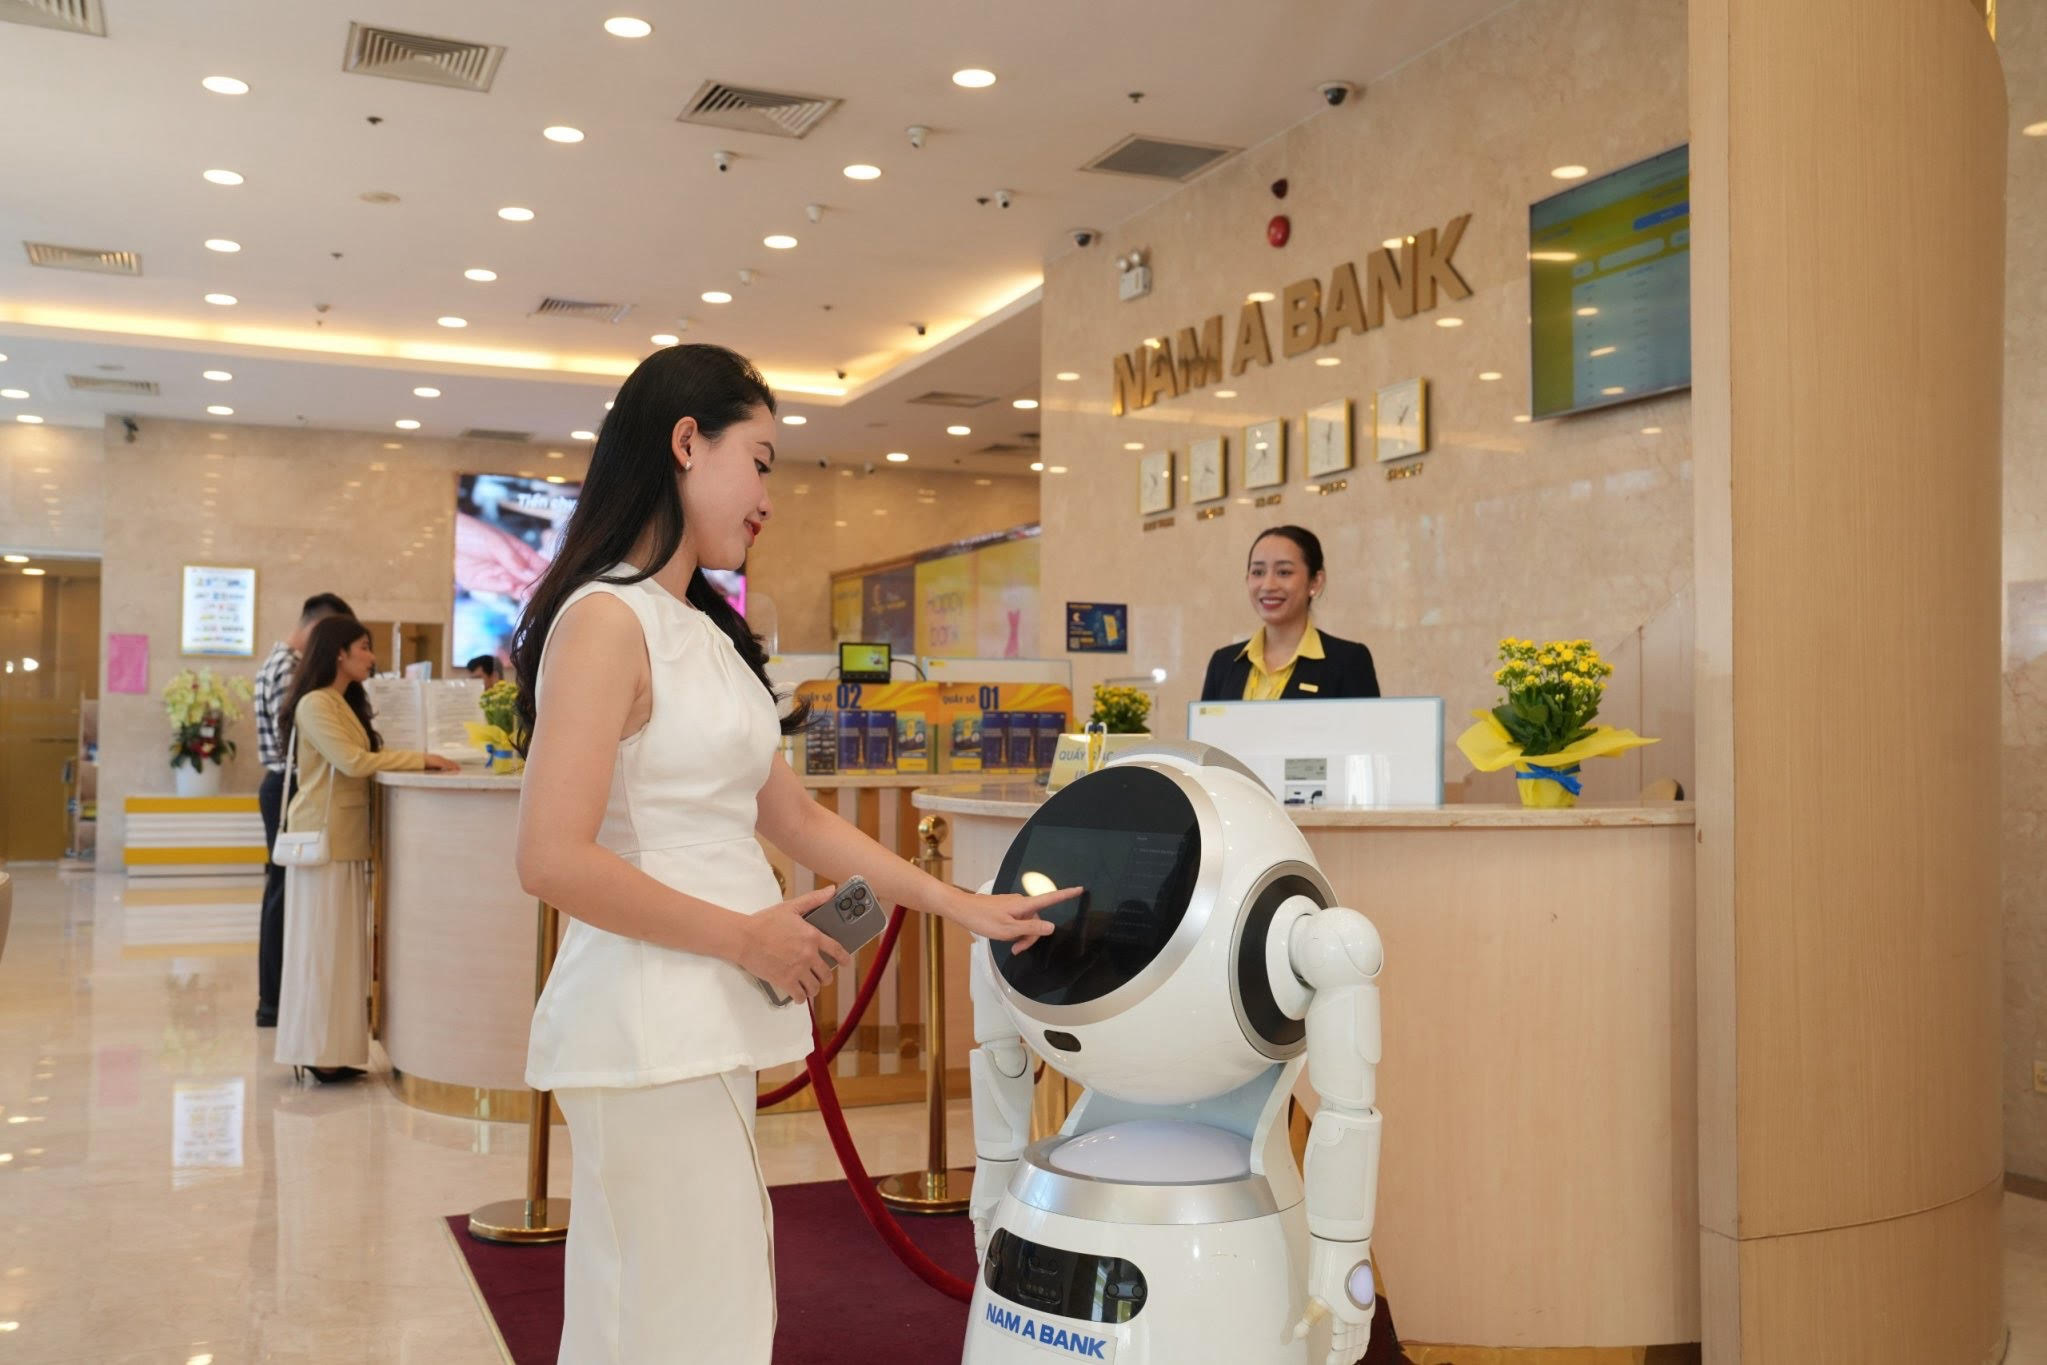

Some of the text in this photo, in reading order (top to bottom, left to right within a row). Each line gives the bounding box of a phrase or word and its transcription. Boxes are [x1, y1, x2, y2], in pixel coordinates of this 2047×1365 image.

[1112, 213, 1474, 417] NAM A BANK
[837, 683, 862, 709] 02
[979, 685, 1000, 710] 01
[986, 1303, 1107, 1359] NAM A BANK
